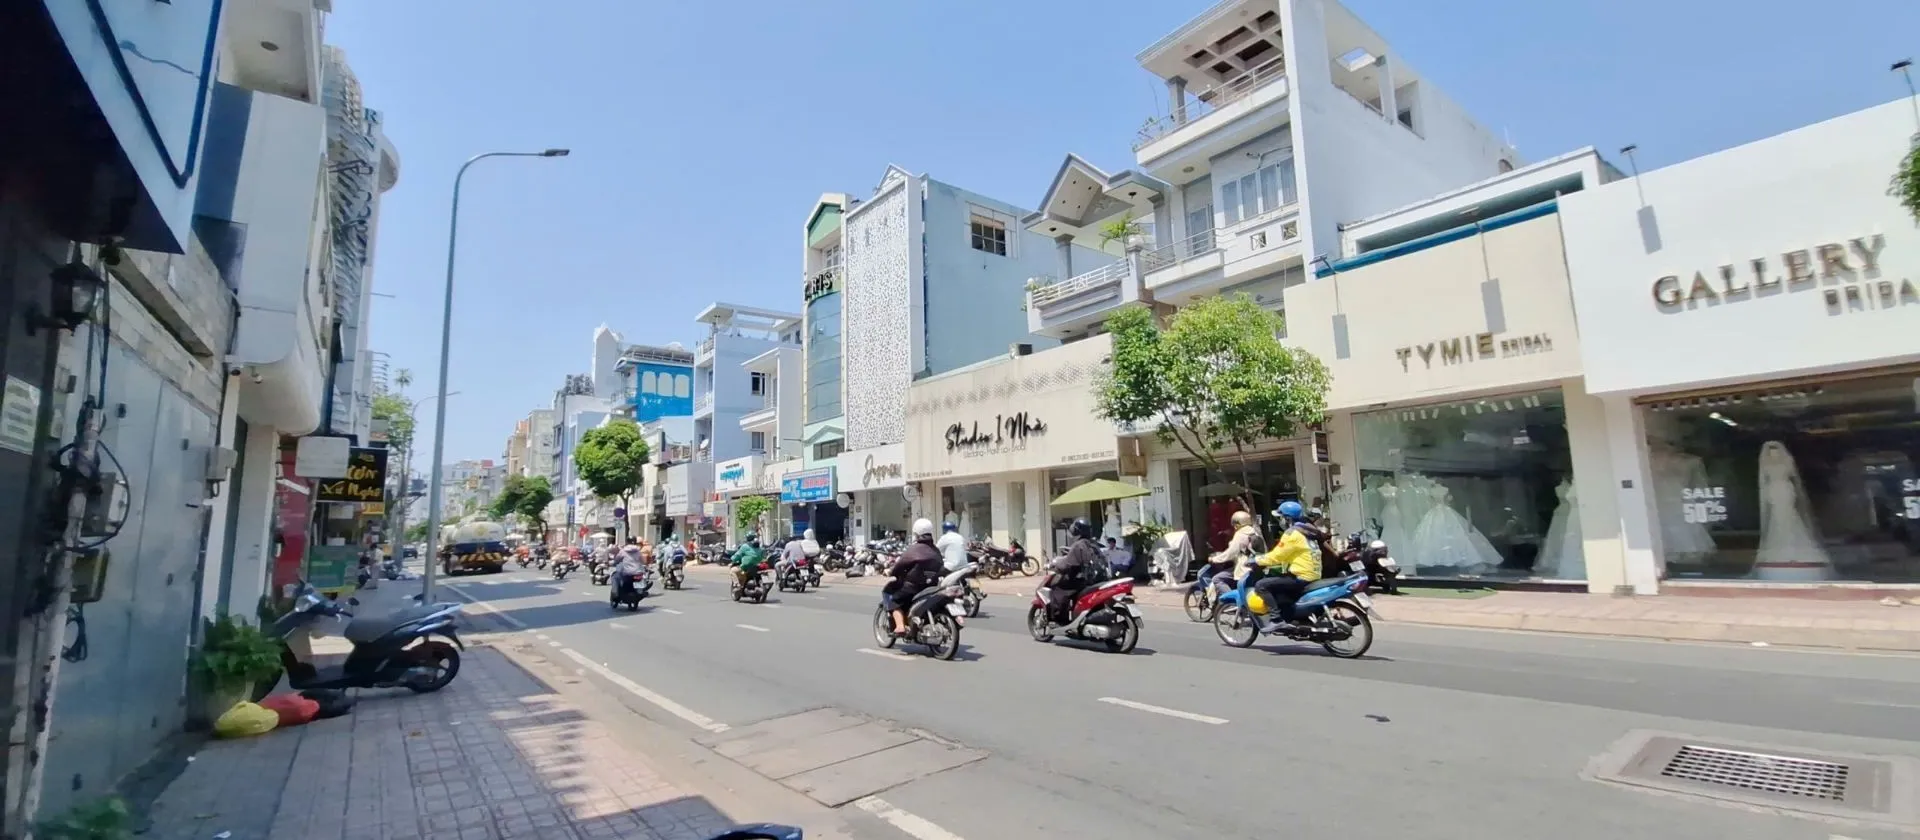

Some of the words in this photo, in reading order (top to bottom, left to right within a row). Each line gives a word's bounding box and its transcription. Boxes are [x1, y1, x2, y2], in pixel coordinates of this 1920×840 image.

[1652, 233, 1885, 309] GALLERY
[1395, 331, 1495, 373] TYMIE
[1500, 332, 1553, 352] BRIDAL
[945, 420, 993, 451] Studio
[1682, 486, 1725, 499] SALE
[1683, 500, 1727, 524] 50%
